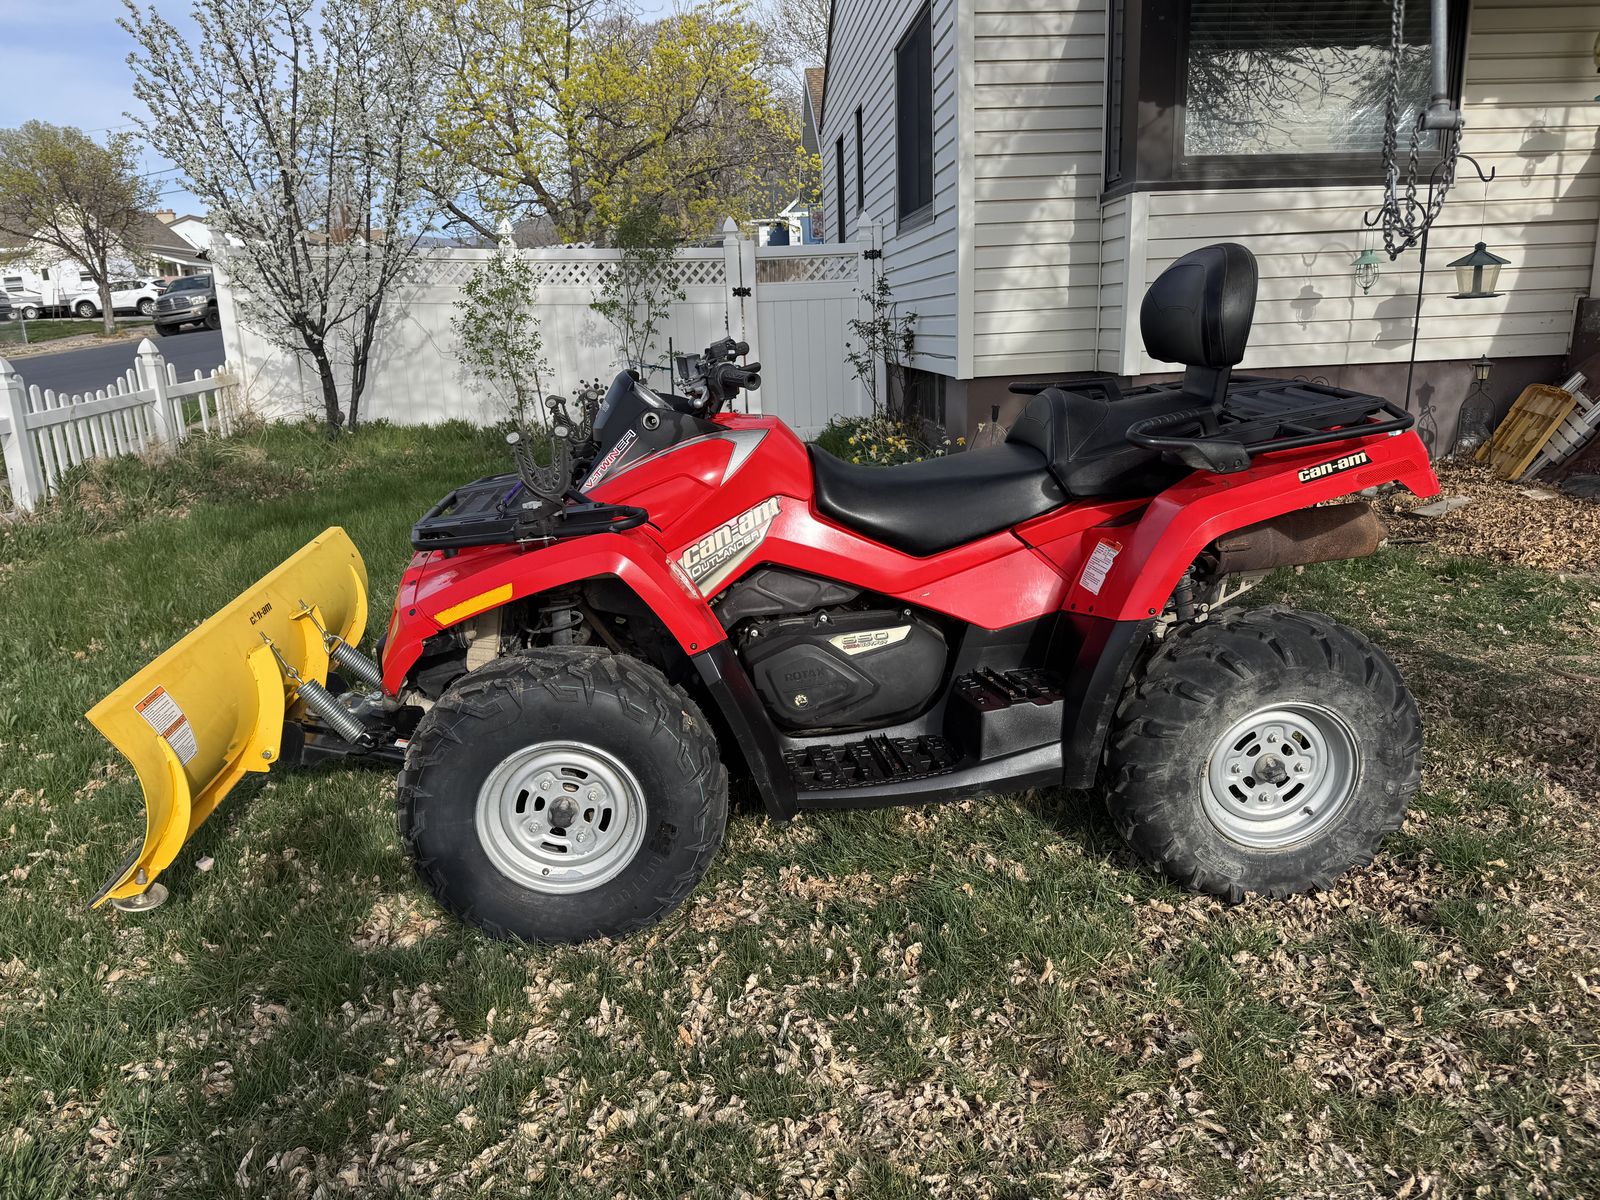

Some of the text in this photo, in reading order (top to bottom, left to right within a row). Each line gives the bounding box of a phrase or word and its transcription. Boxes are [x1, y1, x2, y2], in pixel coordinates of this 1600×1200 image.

[1298, 451, 1368, 482] can-am
[682, 496, 782, 570] can-am
[691, 531, 761, 578] OUTLANDER
[249, 602, 272, 625] cn-am
[784, 668, 824, 681] ROTAX
